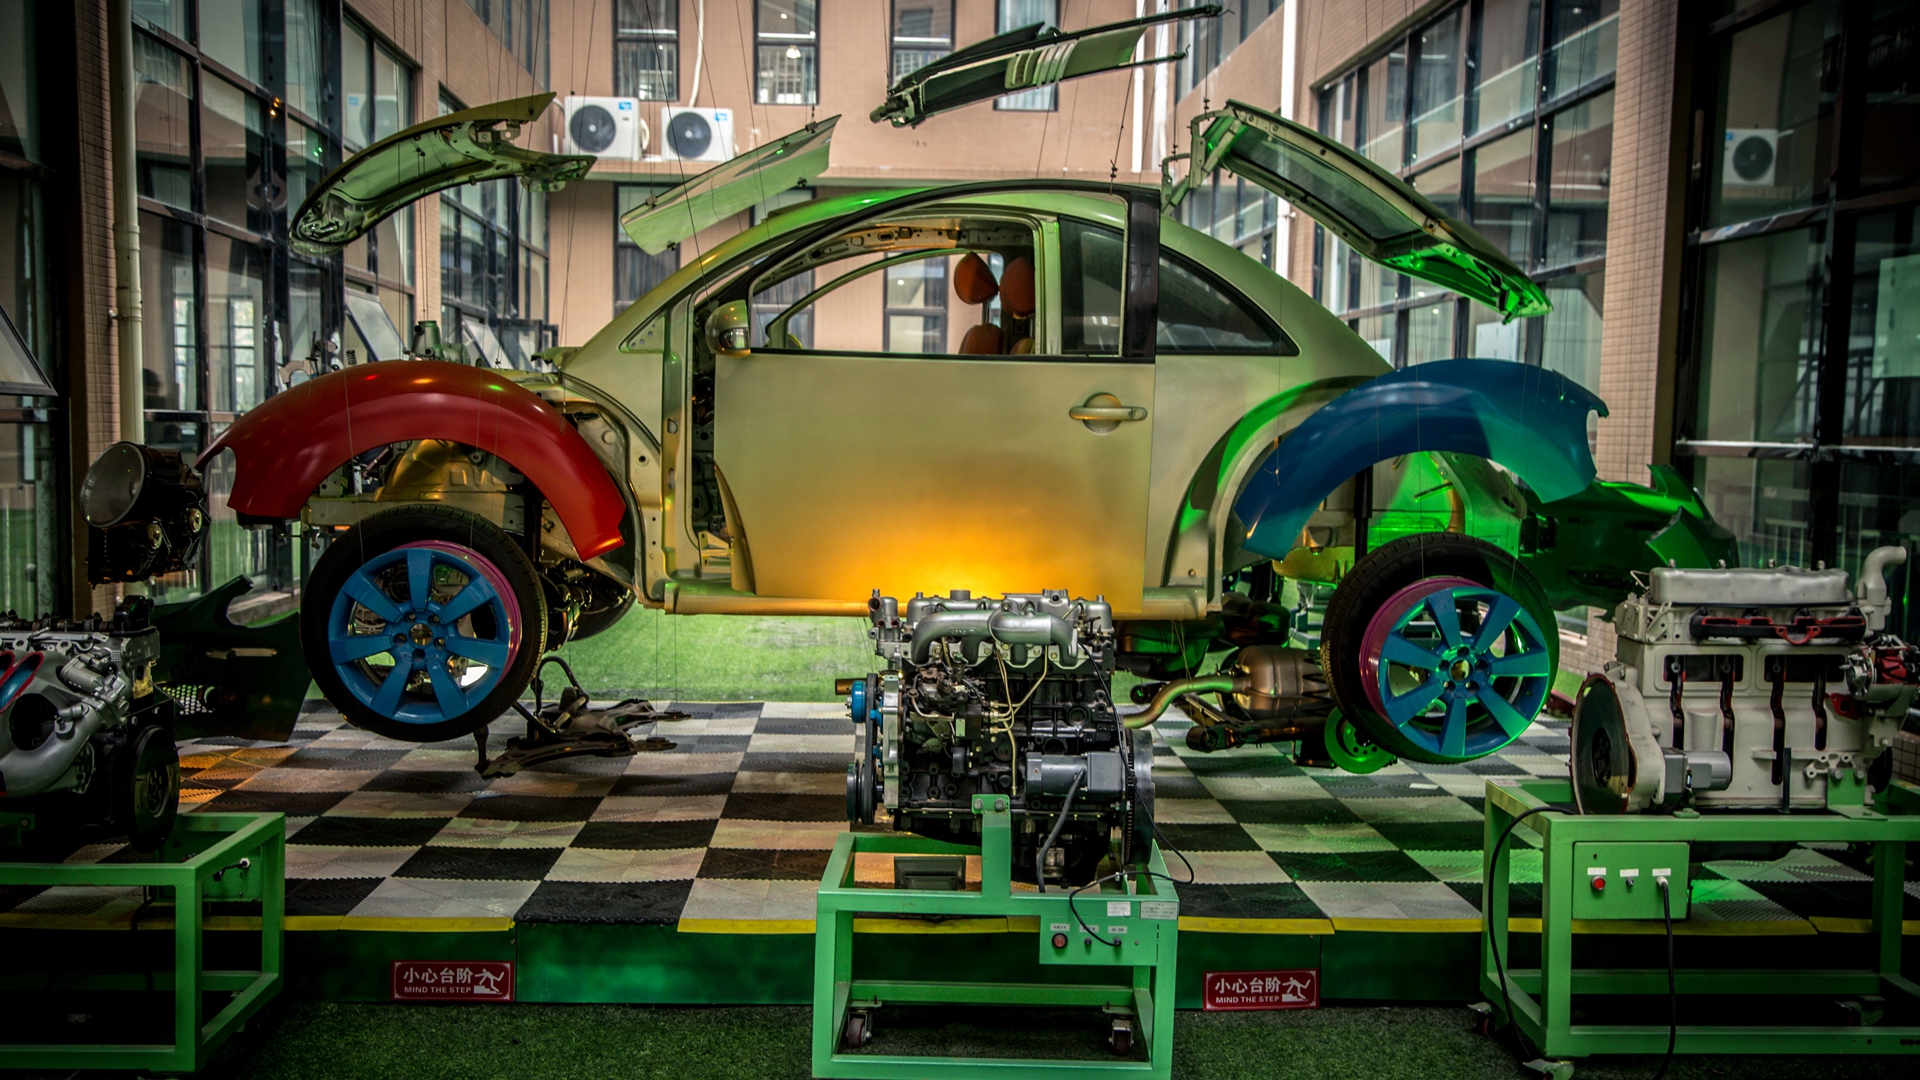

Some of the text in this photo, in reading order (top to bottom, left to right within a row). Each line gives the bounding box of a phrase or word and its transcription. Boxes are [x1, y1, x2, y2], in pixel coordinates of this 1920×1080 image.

[403, 967, 473, 983] 小心台阶
[1215, 977, 1281, 993] 小心台阶
